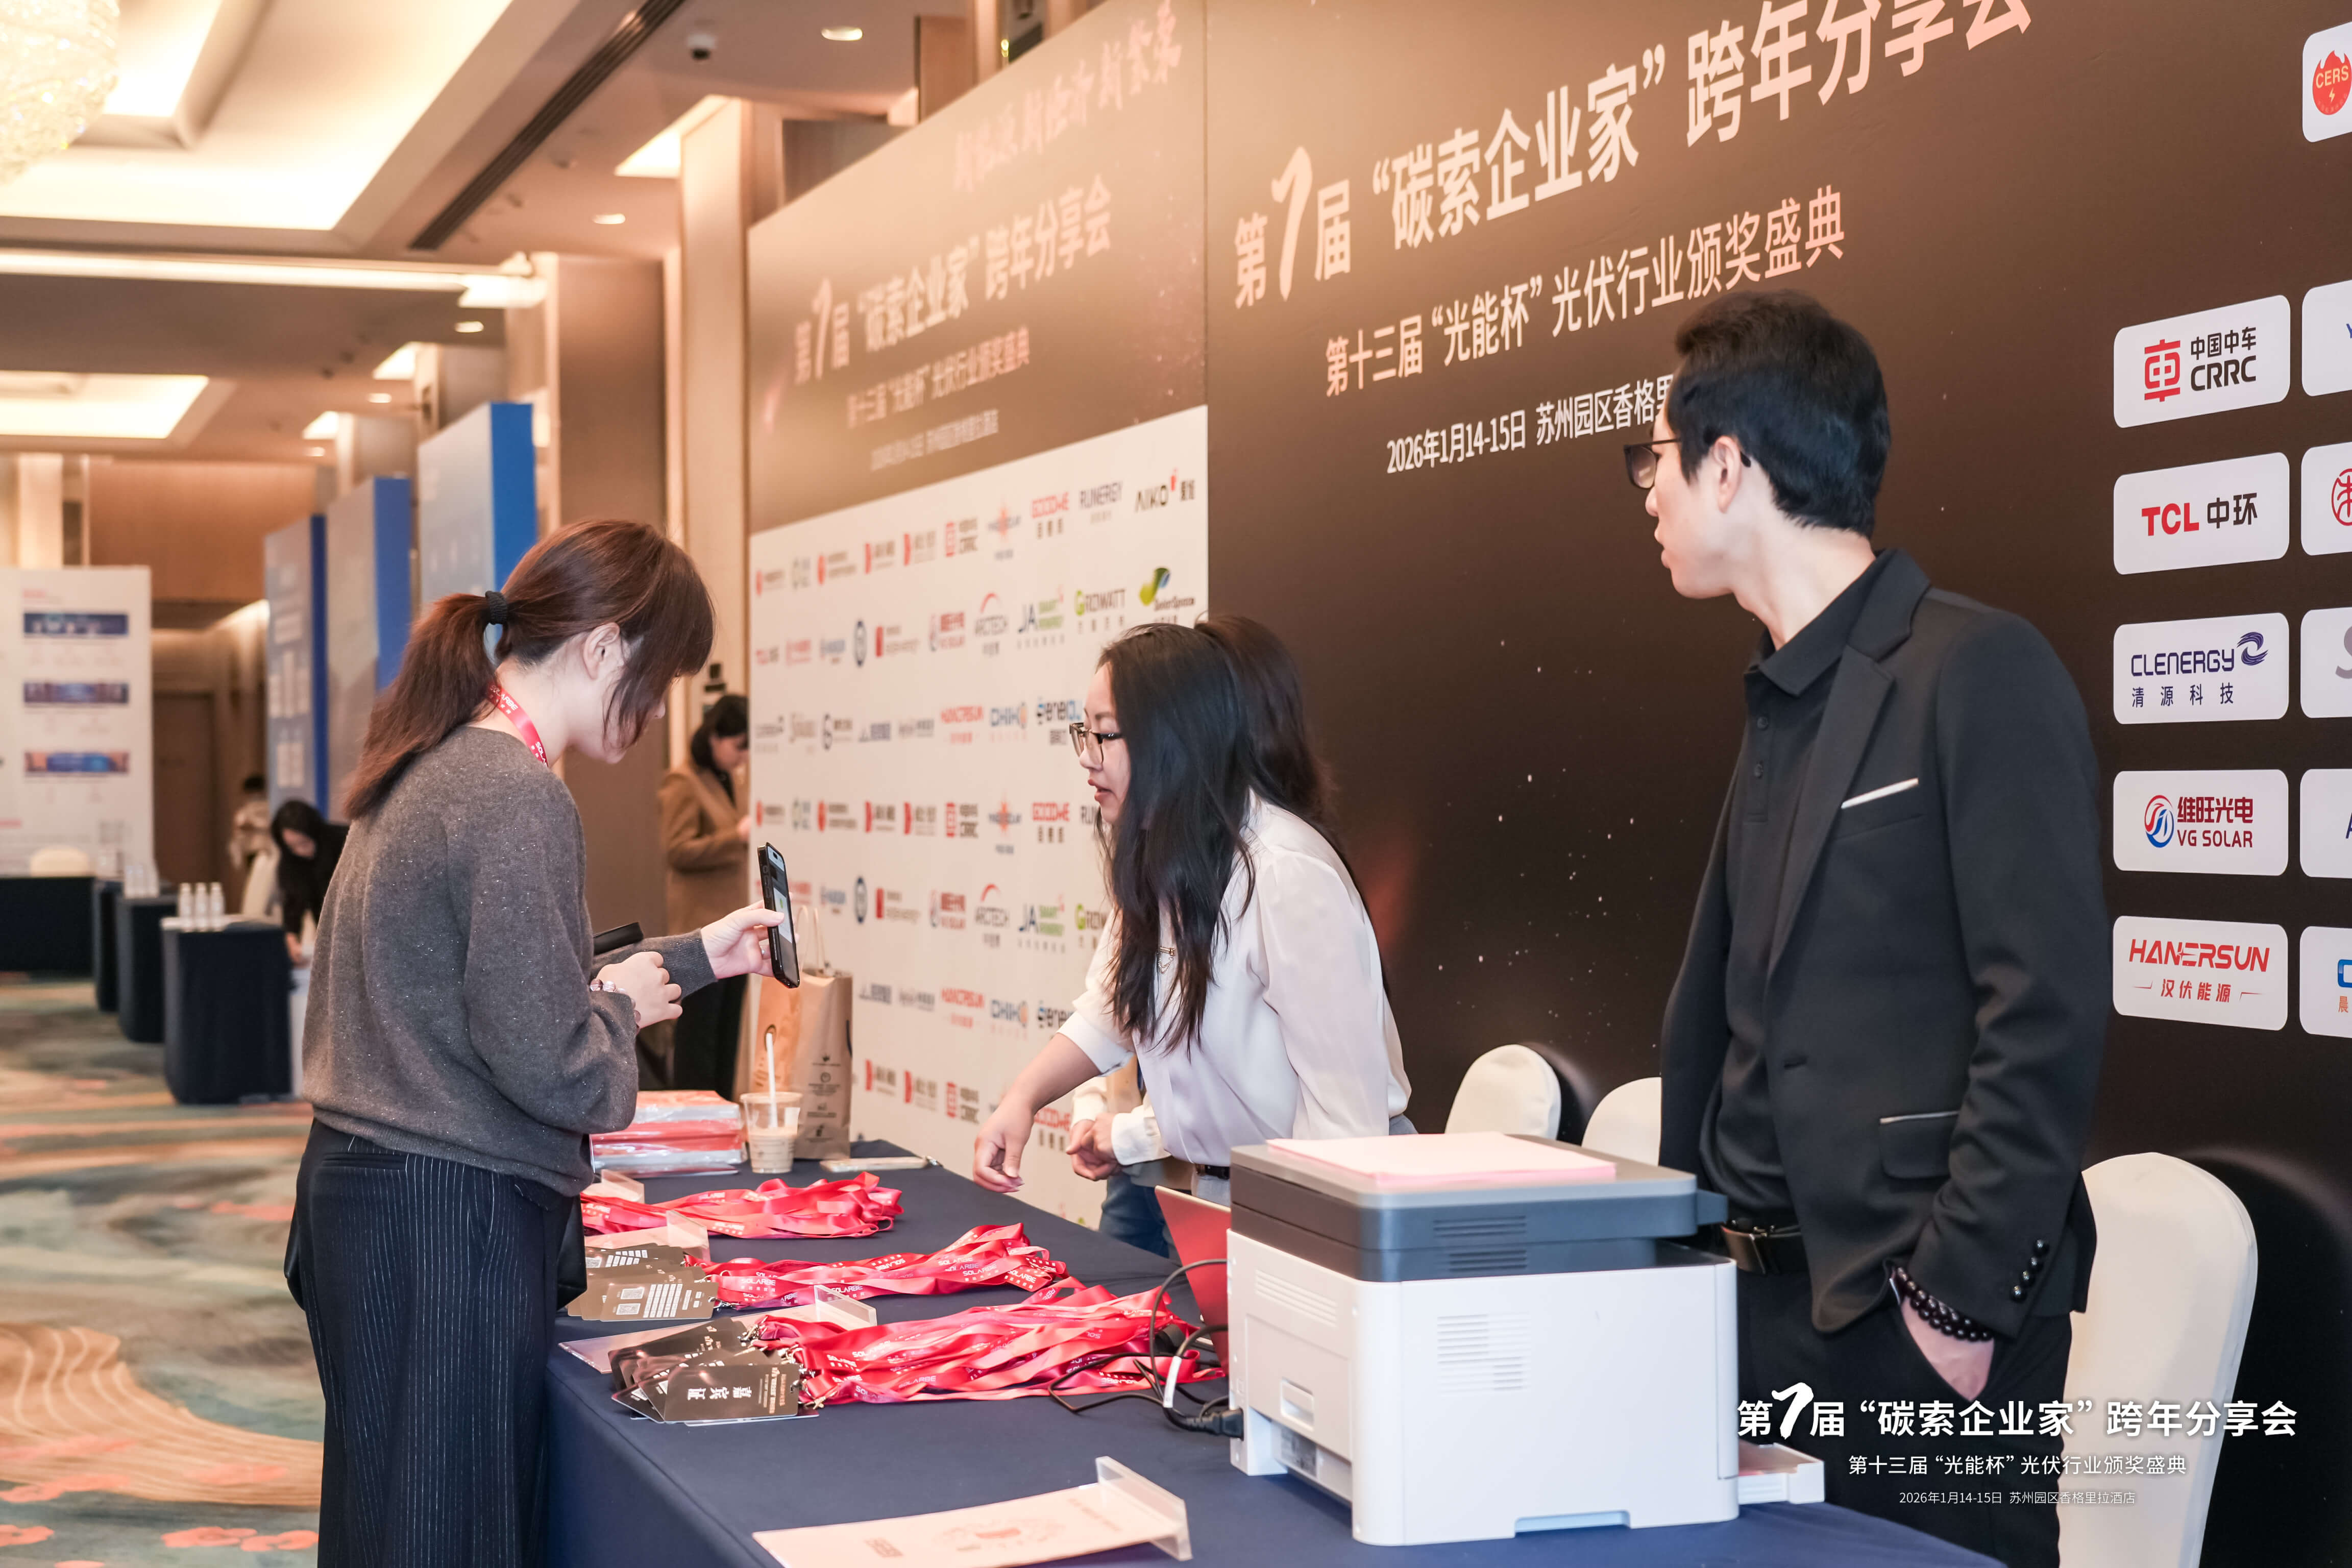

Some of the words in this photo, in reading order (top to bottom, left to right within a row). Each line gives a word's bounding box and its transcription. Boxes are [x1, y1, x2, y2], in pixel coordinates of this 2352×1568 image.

[2316, 65, 2349, 89] CERS
[1234, 146, 1351, 309] 第7届
[1372, 44, 1665, 250] “碳索企业家”
[1326, 315, 1423, 397] 第十三届
[1431, 275, 1542, 366] “光能杯”
[1552, 185, 1845, 337] 光伏行业颁奖盛典
[2190, 327, 2256, 360] 中国中车
[2190, 355, 2256, 391] CRRC
[1387, 410, 1526, 474] 2026年1月14-15日
[2141, 502, 2199, 536] TCL
[2207, 493, 2258, 529] 中环
[2131, 649, 2235, 677] CLENERGY
[2132, 682, 2234, 708] 清源科技
[2177, 797, 2253, 823] 维旺光电
[2177, 830, 2197, 847] VG
[2202, 830, 2252, 848] SOLAR
[2129, 939, 2270, 972] HANERSUN
[2161, 978, 2232, 1003] 汉伏能源
[963, 1263, 997, 1276] SOLARBE
[687, 1386, 752, 1401] 嘉宾证
